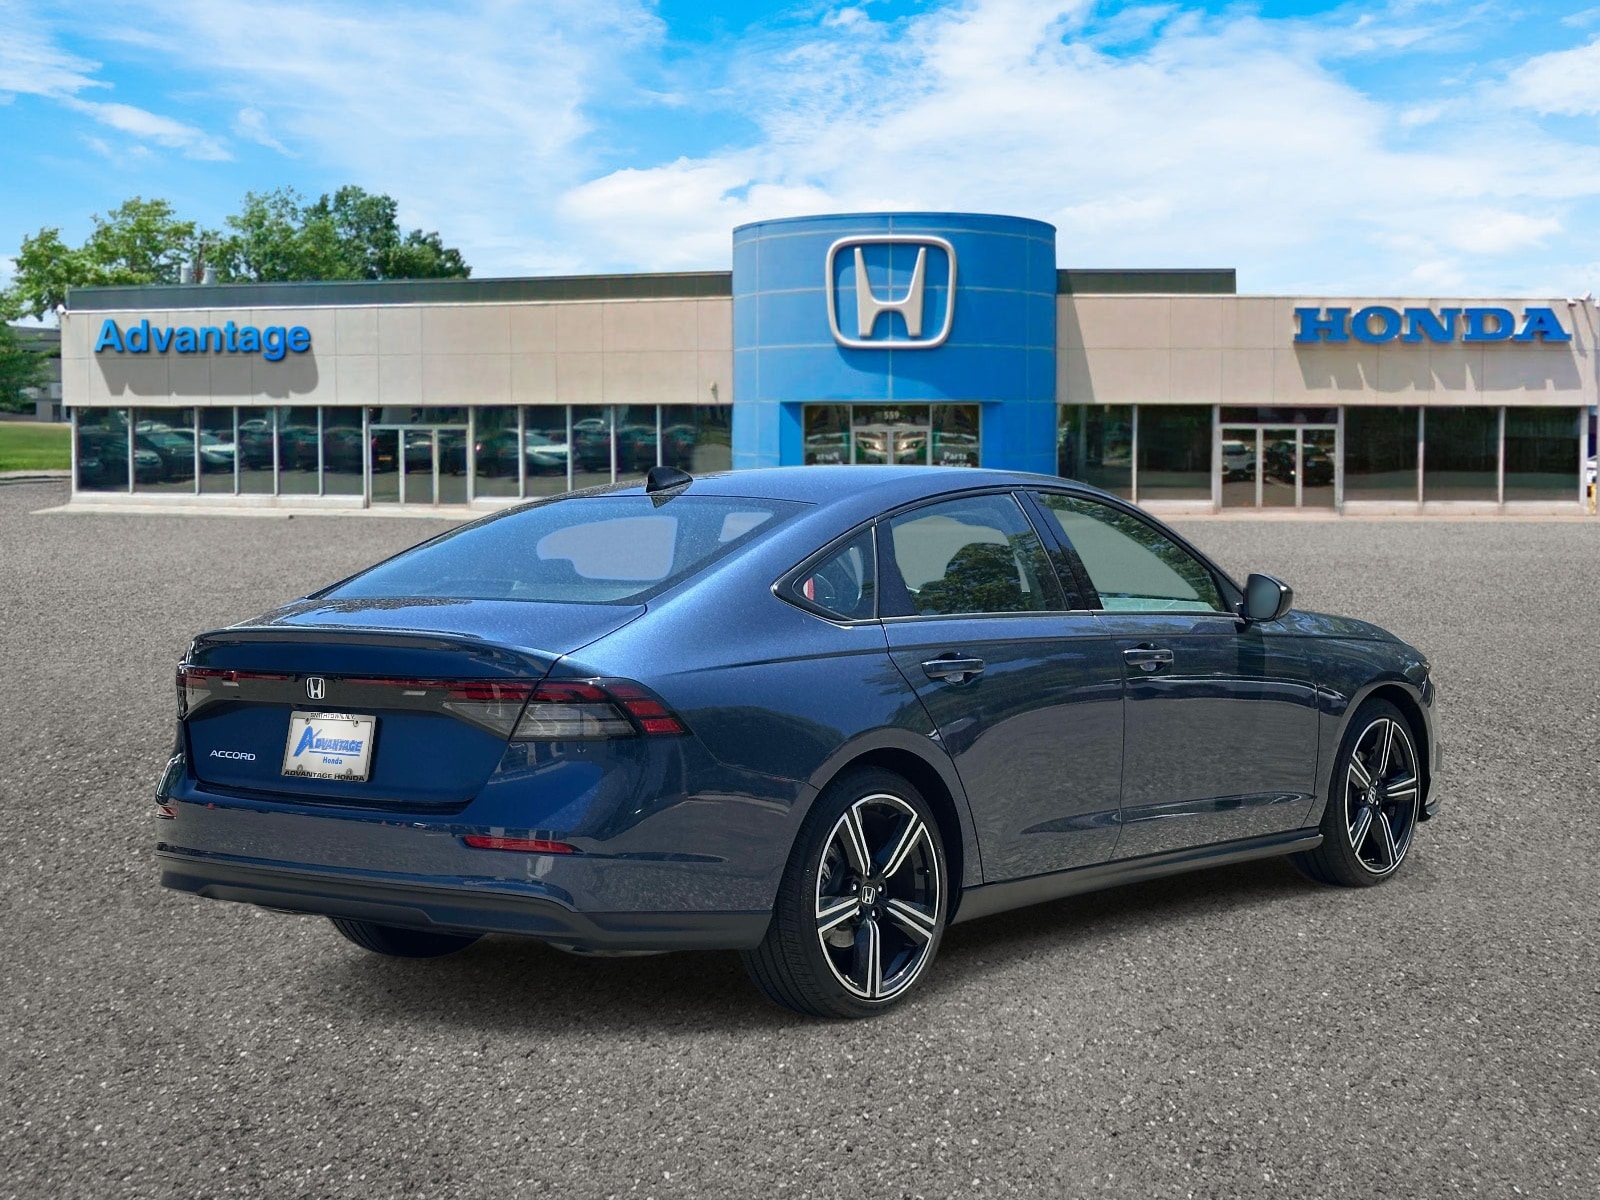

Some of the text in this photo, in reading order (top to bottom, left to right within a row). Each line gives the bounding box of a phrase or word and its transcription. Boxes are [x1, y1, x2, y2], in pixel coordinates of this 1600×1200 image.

[1294, 306, 1573, 343] HONDA
[95, 319, 311, 361] Advantage
[944, 451, 967, 460] Parts
[293, 725, 363, 757] ADVANTAGE
[209, 750, 256, 760] ACCORD
[322, 756, 343, 765] Honda
[284, 770, 365, 782] ADVANTAGE HONDA
